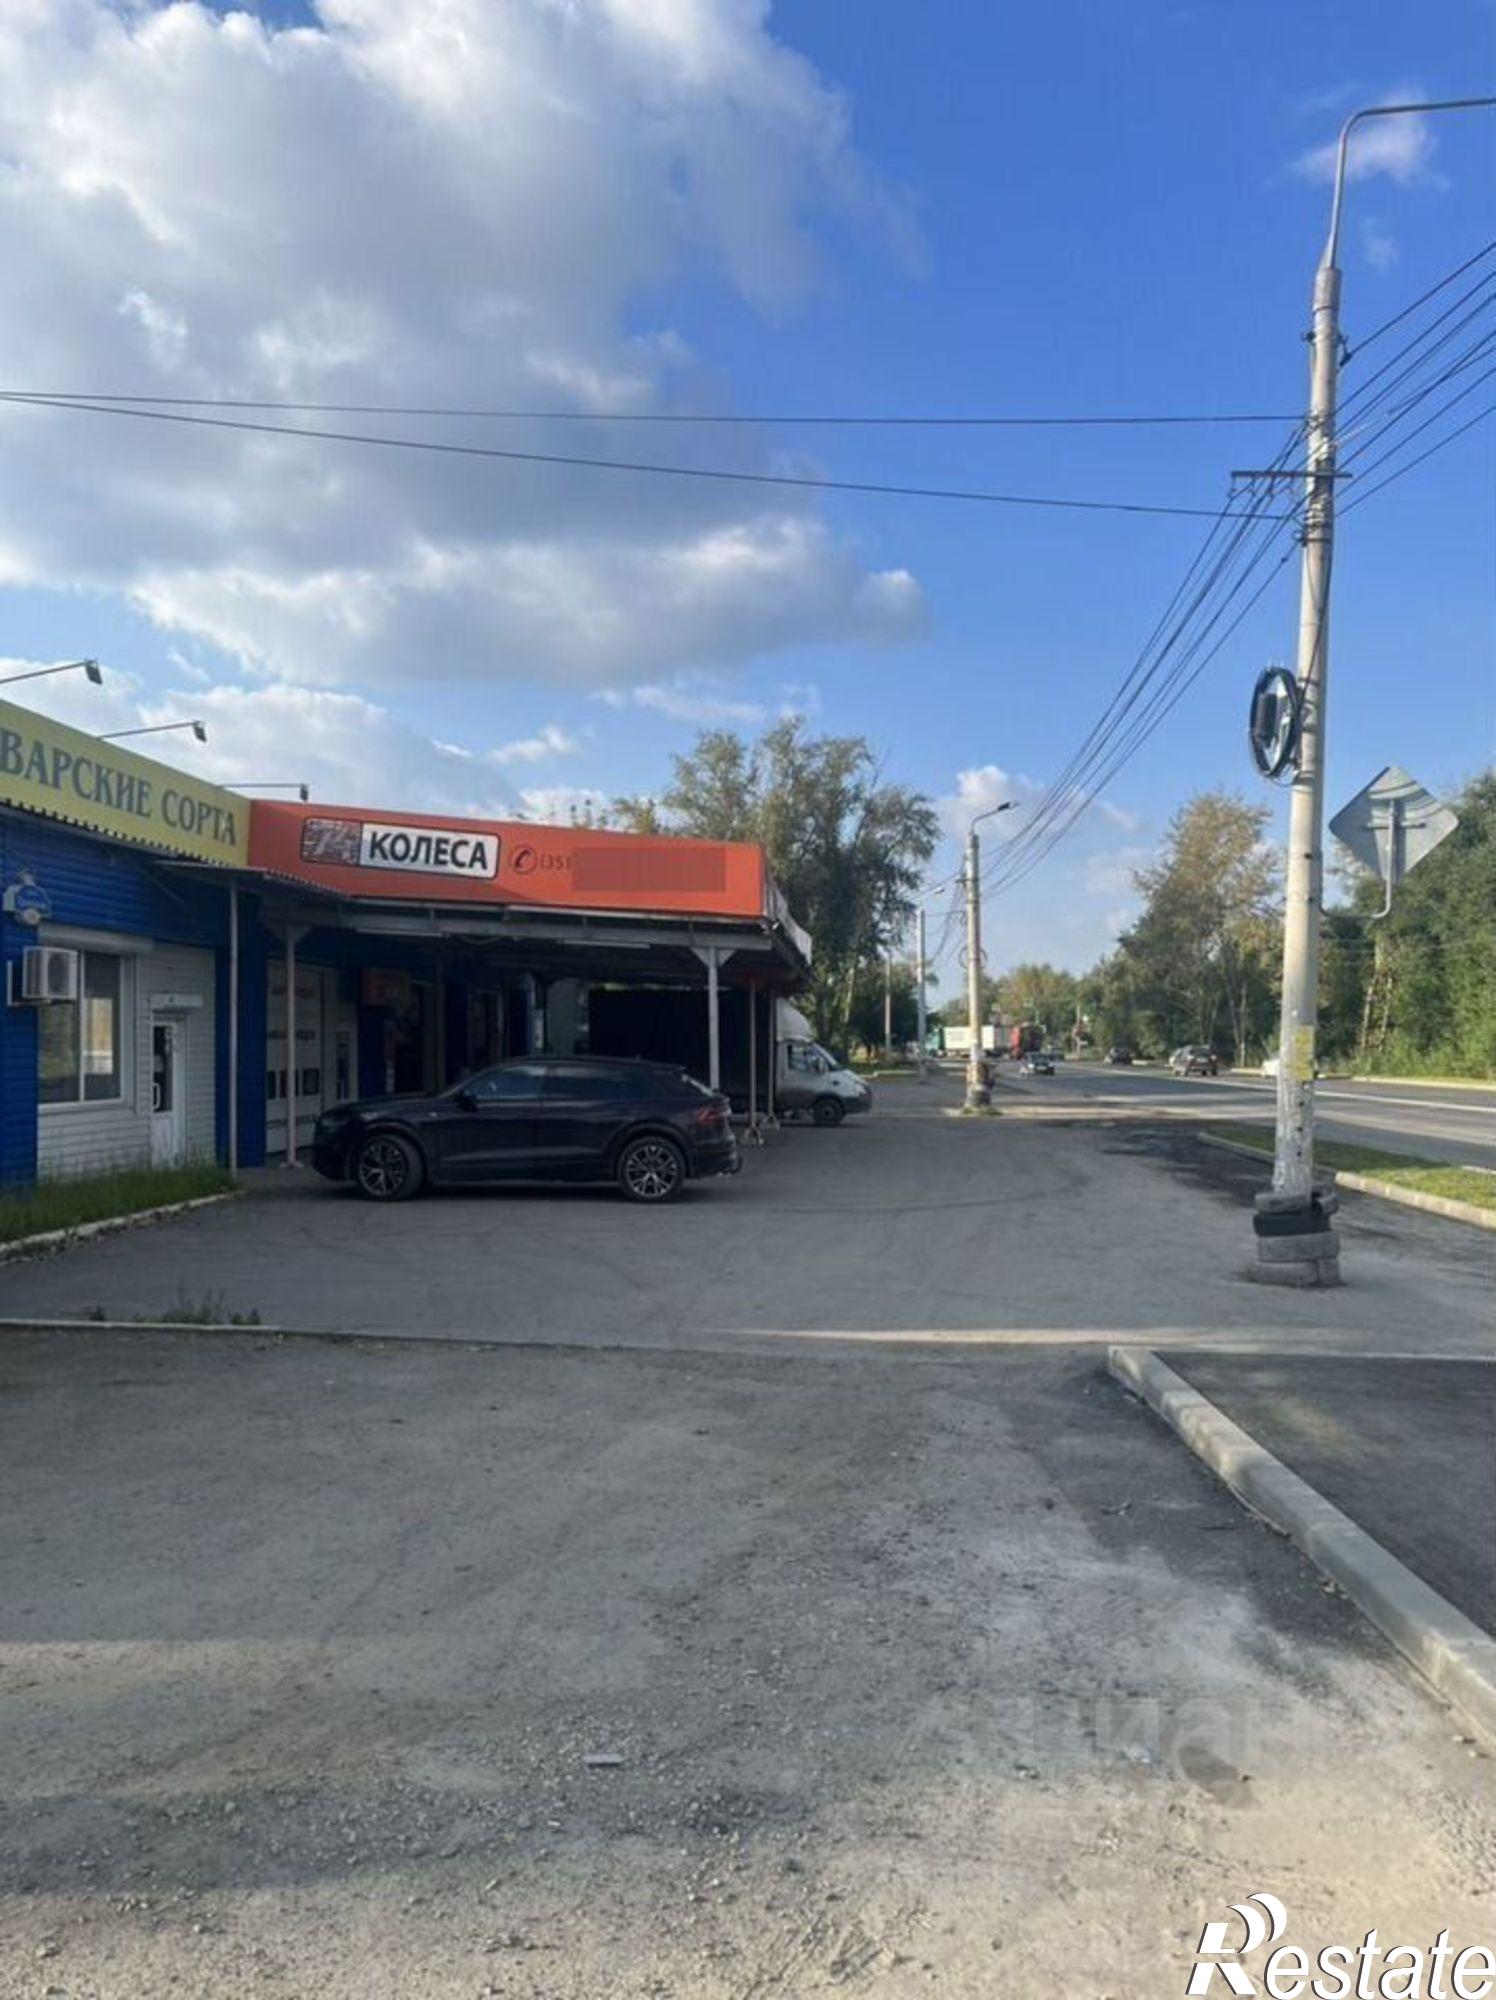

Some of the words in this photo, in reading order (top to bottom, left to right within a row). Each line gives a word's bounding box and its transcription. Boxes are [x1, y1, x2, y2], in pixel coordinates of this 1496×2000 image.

[0, 728, 152, 818] ВАРСКИЕ
[162, 789, 236, 846] СОРТА
[369, 831, 487, 871] КОЛЕСА
